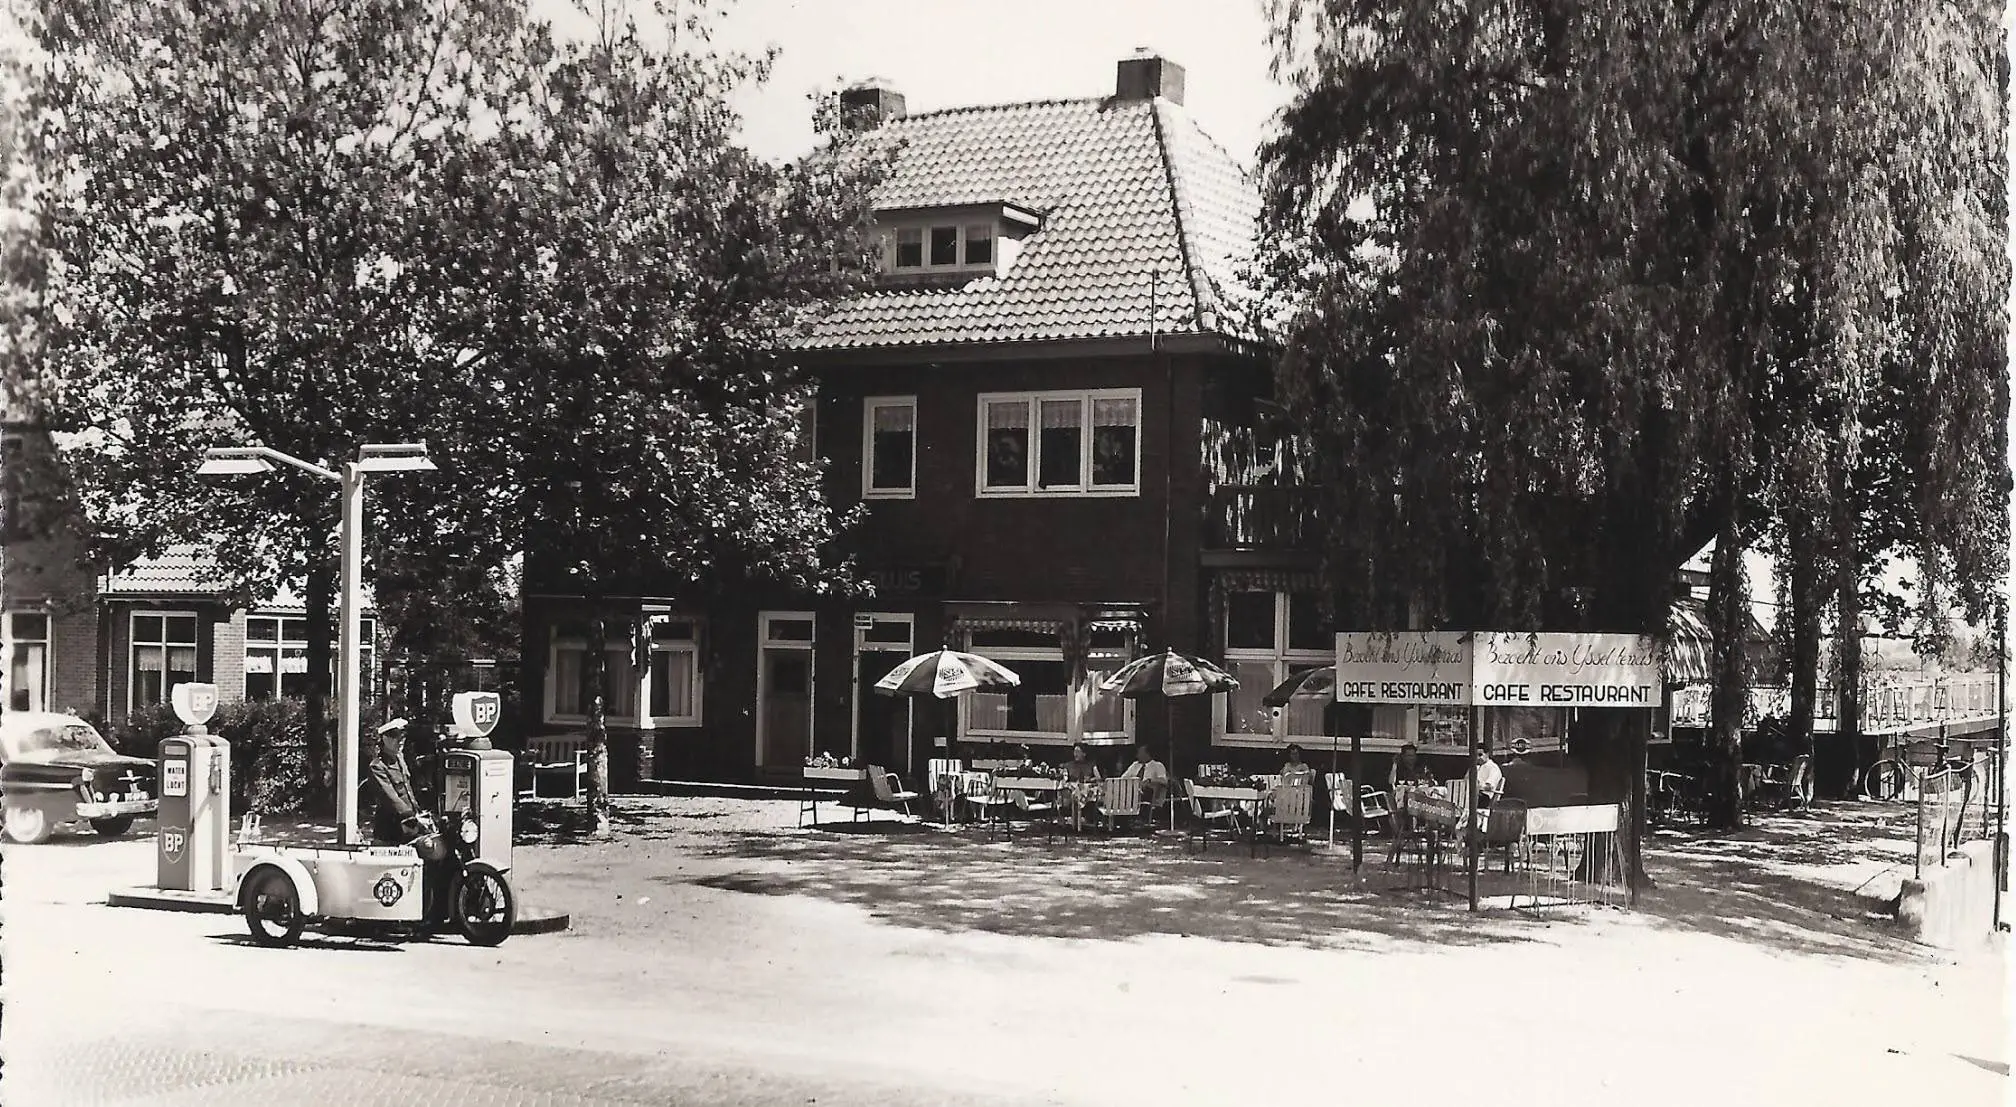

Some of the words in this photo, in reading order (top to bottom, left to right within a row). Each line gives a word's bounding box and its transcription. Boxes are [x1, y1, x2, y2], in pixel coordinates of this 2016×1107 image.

[1543, 651, 1568, 665] ons
[1343, 681, 1376, 698] CAFE
[1381, 682, 1464, 700] RESTAURANT
[1483, 684, 1530, 701] CAFE
[1540, 685, 1652, 703] RESTAURANT
[192, 691, 214, 711] BP
[475, 702, 497, 724] BP
[167, 766, 185, 775] WATER
[164, 832, 184, 853] BP
